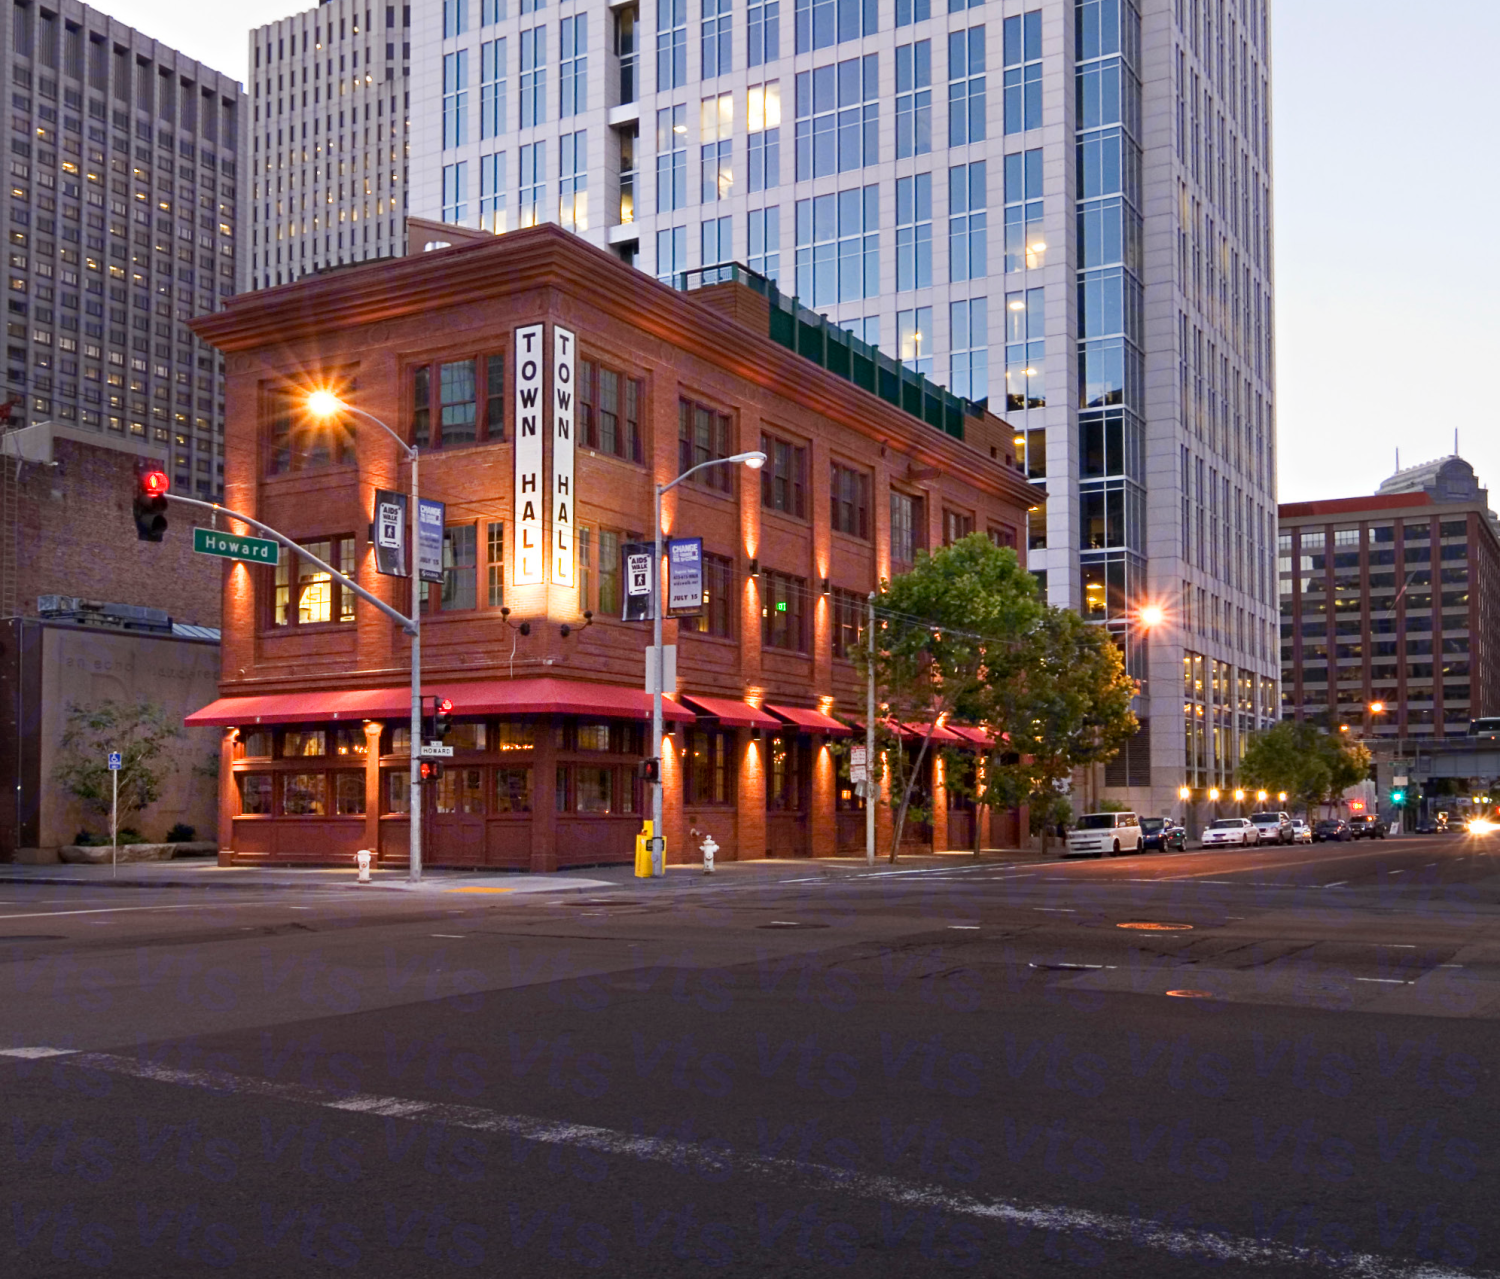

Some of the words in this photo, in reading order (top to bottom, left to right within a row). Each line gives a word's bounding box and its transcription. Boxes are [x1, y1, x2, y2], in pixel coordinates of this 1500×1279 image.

[520, 332, 539, 438] TOWN
[557, 334, 571, 440] TOWN
[383, 506, 399, 515] AIDS
[383, 513, 398, 522] WALK
[522, 473, 536, 576] HALL
[558, 474, 569, 578] HALL
[205, 535, 268, 558] Howard
[631, 556, 648, 564] AIDS
